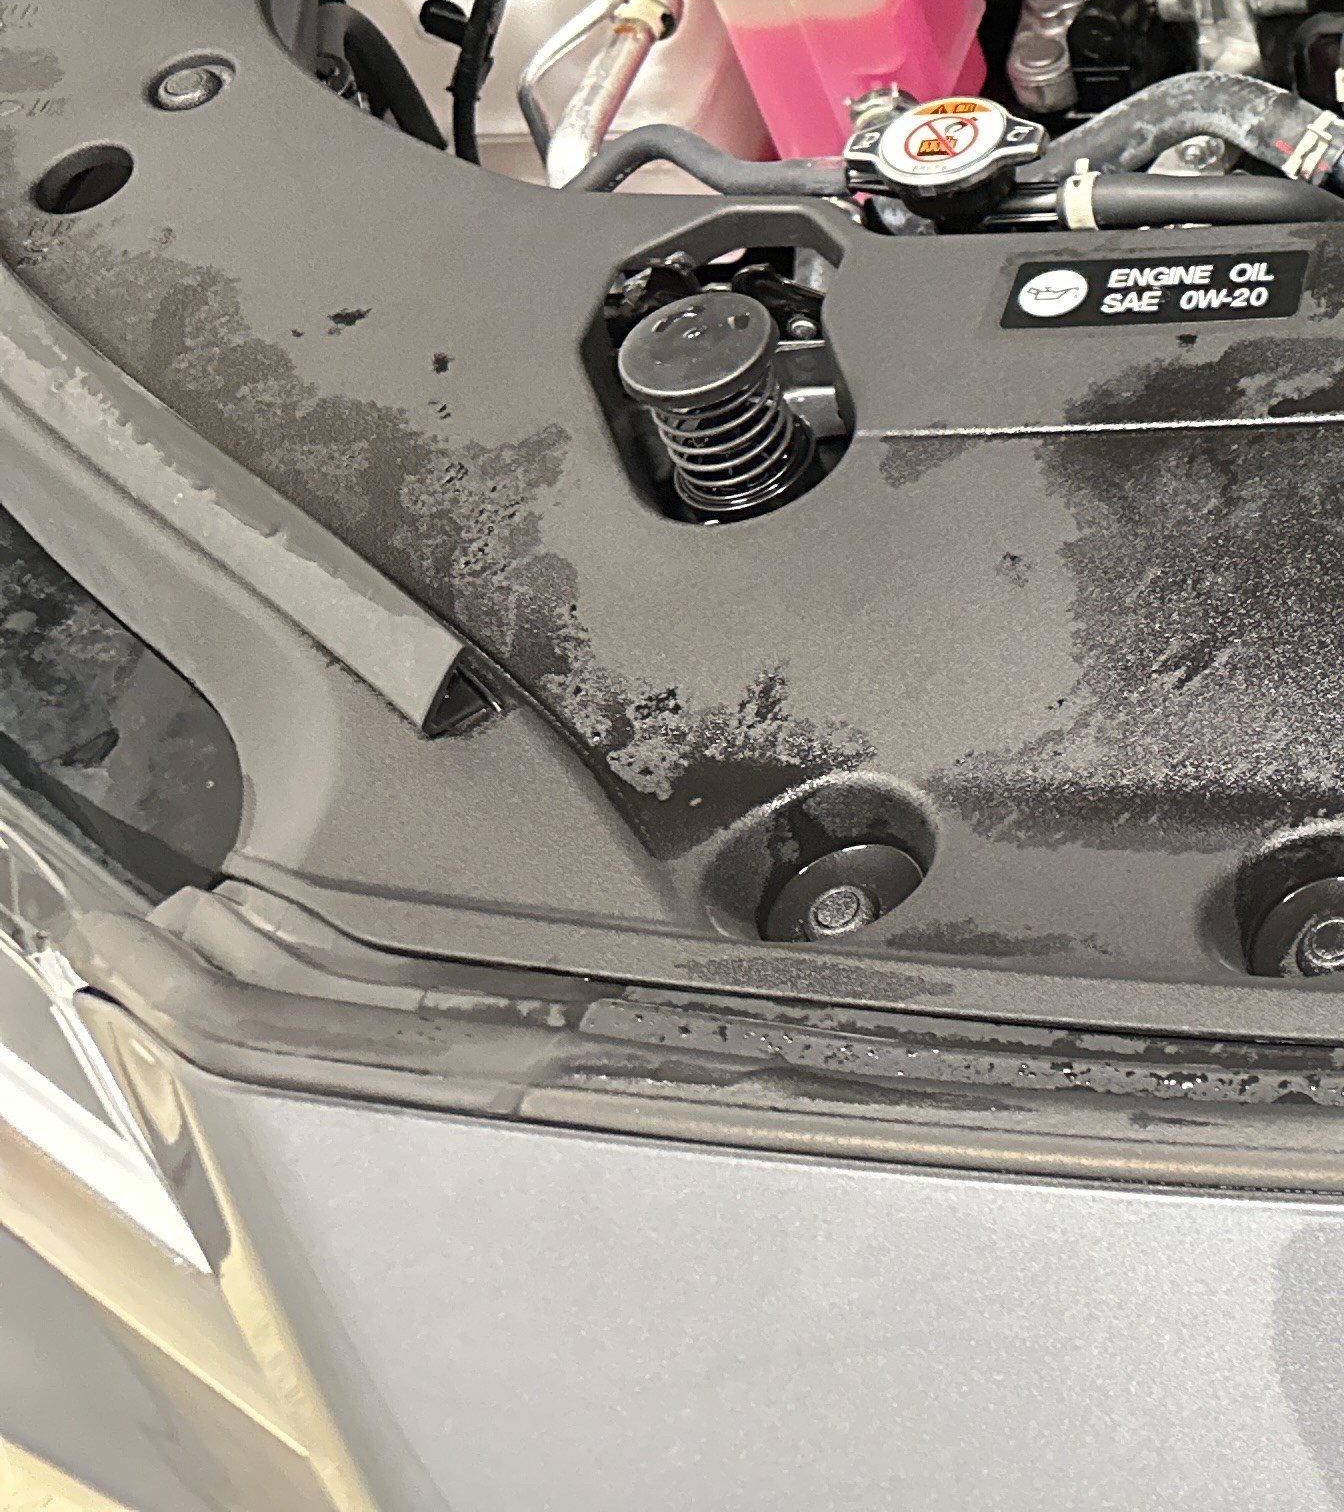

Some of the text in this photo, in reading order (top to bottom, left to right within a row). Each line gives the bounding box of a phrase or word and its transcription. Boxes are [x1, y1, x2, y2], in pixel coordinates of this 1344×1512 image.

[1107, 262, 1275, 288] ENGINE OIL
[1100, 287, 1269, 314] SAE 0W-20
